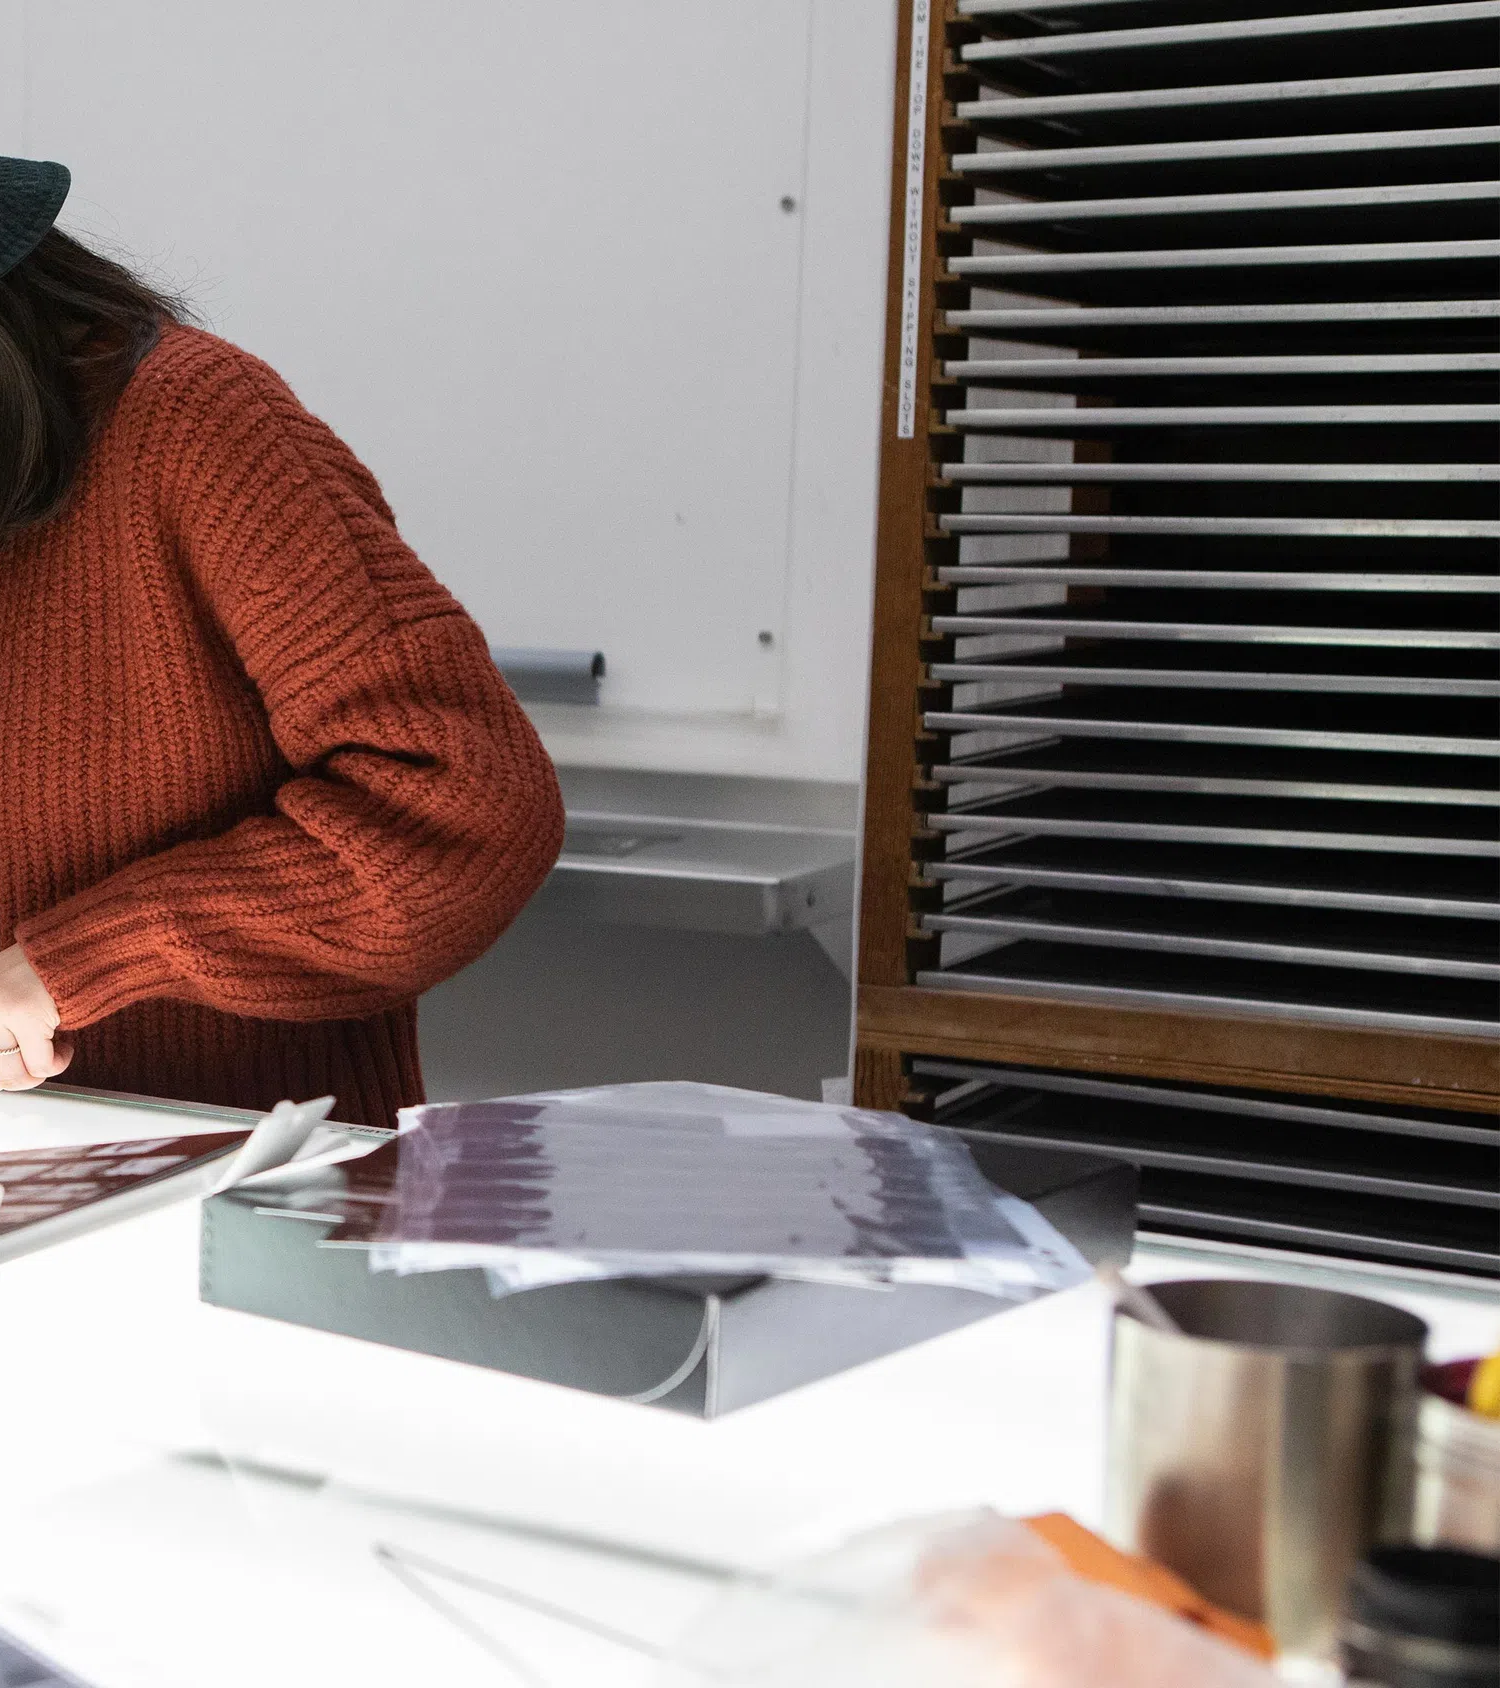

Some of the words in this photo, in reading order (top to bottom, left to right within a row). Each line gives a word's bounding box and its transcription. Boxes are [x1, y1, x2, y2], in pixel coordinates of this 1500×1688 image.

[915, 35, 924, 69] THE
[913, 82, 923, 115] TOP
[911, 128, 921, 172] DOWN
[909, 186, 920, 264] WITHOUT
[905, 277, 916, 367] SKIPPING
[902, 379, 912, 434] SLOTS
